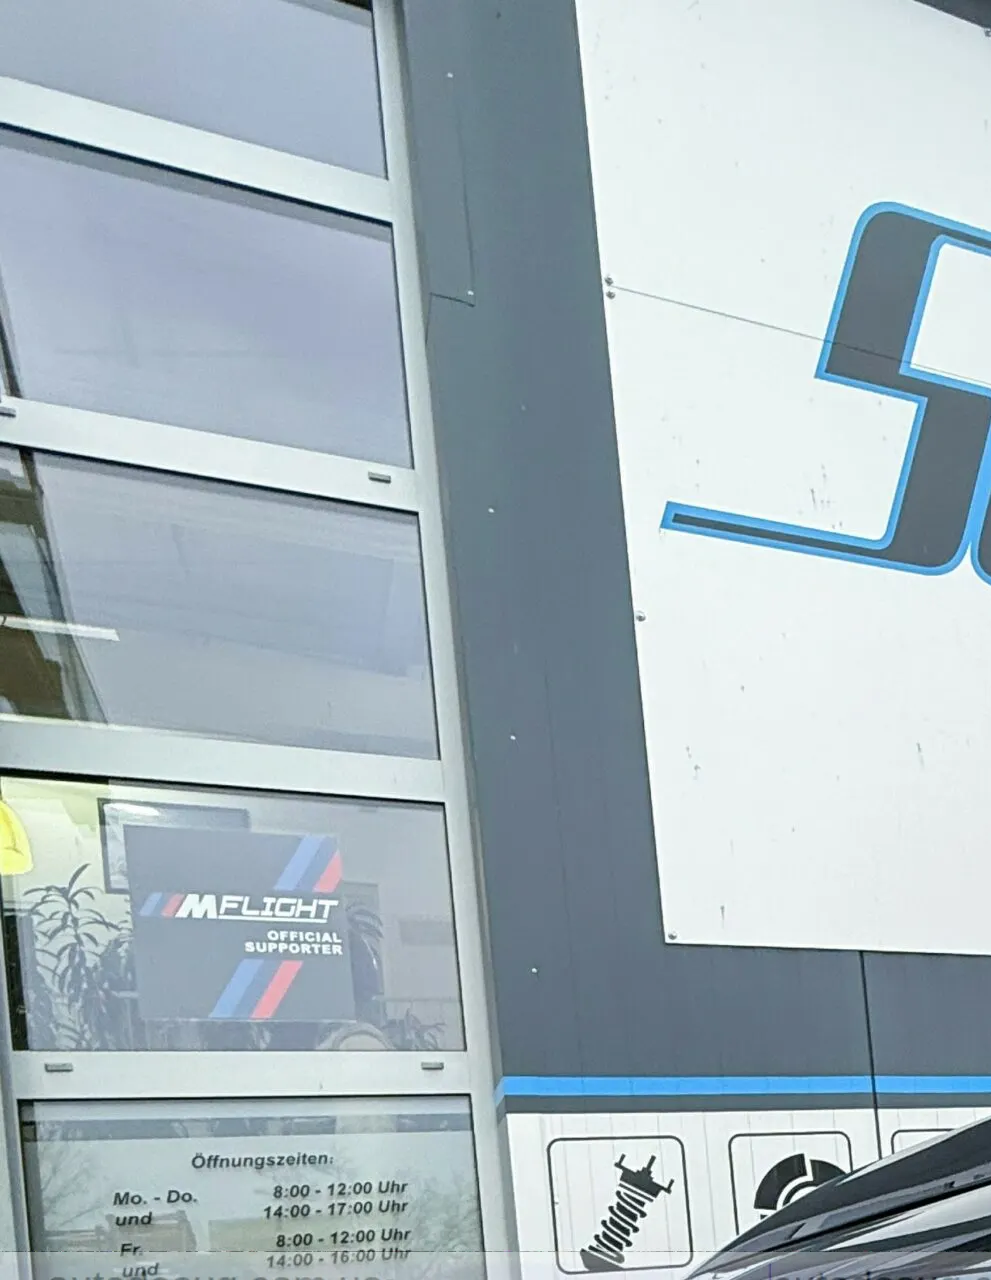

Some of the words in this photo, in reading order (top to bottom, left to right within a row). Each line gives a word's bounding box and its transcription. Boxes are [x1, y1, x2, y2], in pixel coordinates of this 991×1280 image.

[267, 930, 343, 943] OFFICIAL
[244, 941, 343, 955] SUPPORTER
[191, 1152, 334, 1171] Öffnungszeiten:
[273, 1184, 310, 1199] 8:00
[327, 1182, 372, 1197] 12:00
[378, 1180, 408, 1194] Uhr
[113, 1192, 147, 1206] Mo.
[166, 1190, 198, 1204] Do.
[263, 1204, 310, 1219] 14:00
[328, 1201, 373, 1216] 17:00
[378, 1199, 408, 1214] Uhr
[115, 1212, 153, 1227] und
[276, 1233, 313, 1248] 8:00
[330, 1230, 375, 1245] 12:00
[381, 1228, 411, 1242] Uhr
[120, 1243, 143, 1257] Fr.
[266, 1253, 313, 1268] 14:00
[331, 1250, 375, 1265] 16:00
[381, 1248, 411, 1262] Uhr
[122, 1263, 159, 1278] und
